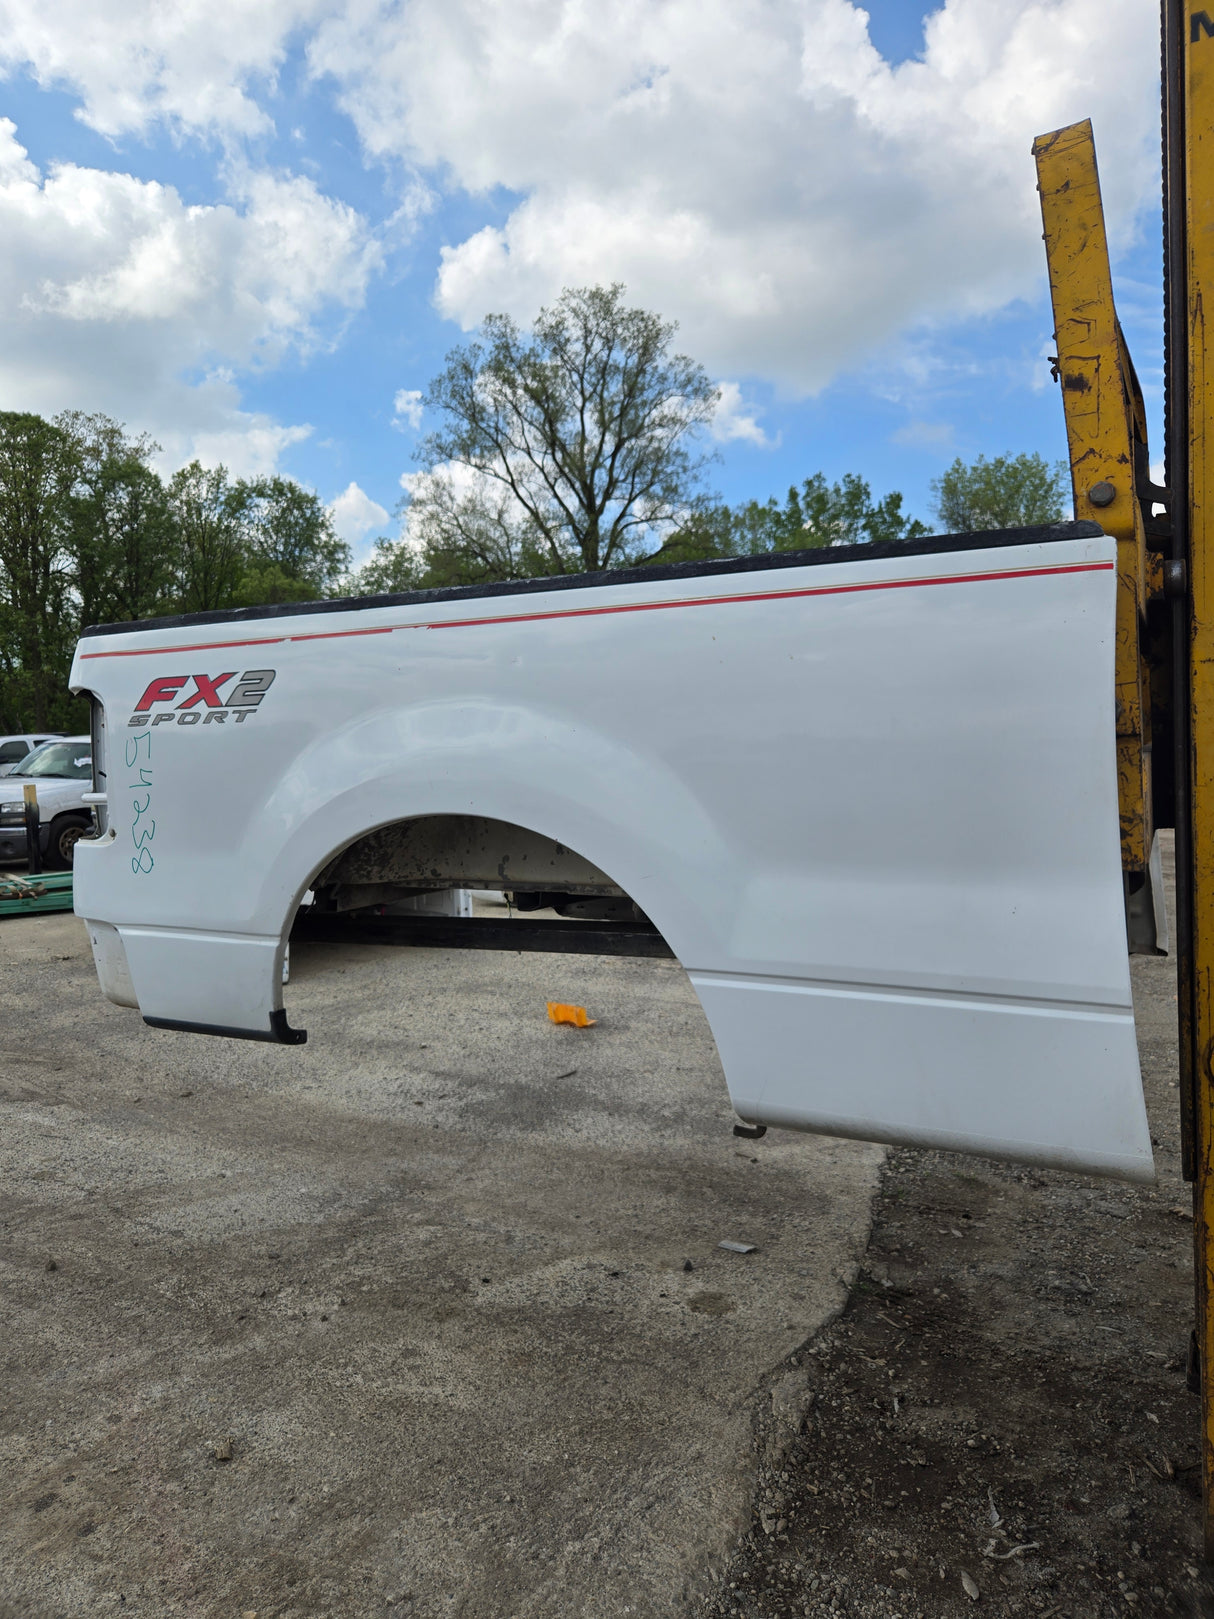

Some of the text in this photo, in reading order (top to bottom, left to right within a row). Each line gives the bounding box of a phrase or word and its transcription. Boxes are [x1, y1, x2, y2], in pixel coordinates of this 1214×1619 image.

[134, 669, 276, 712] FX2
[127, 708, 257, 727] SPORT
[126, 731, 155, 874] 54238
